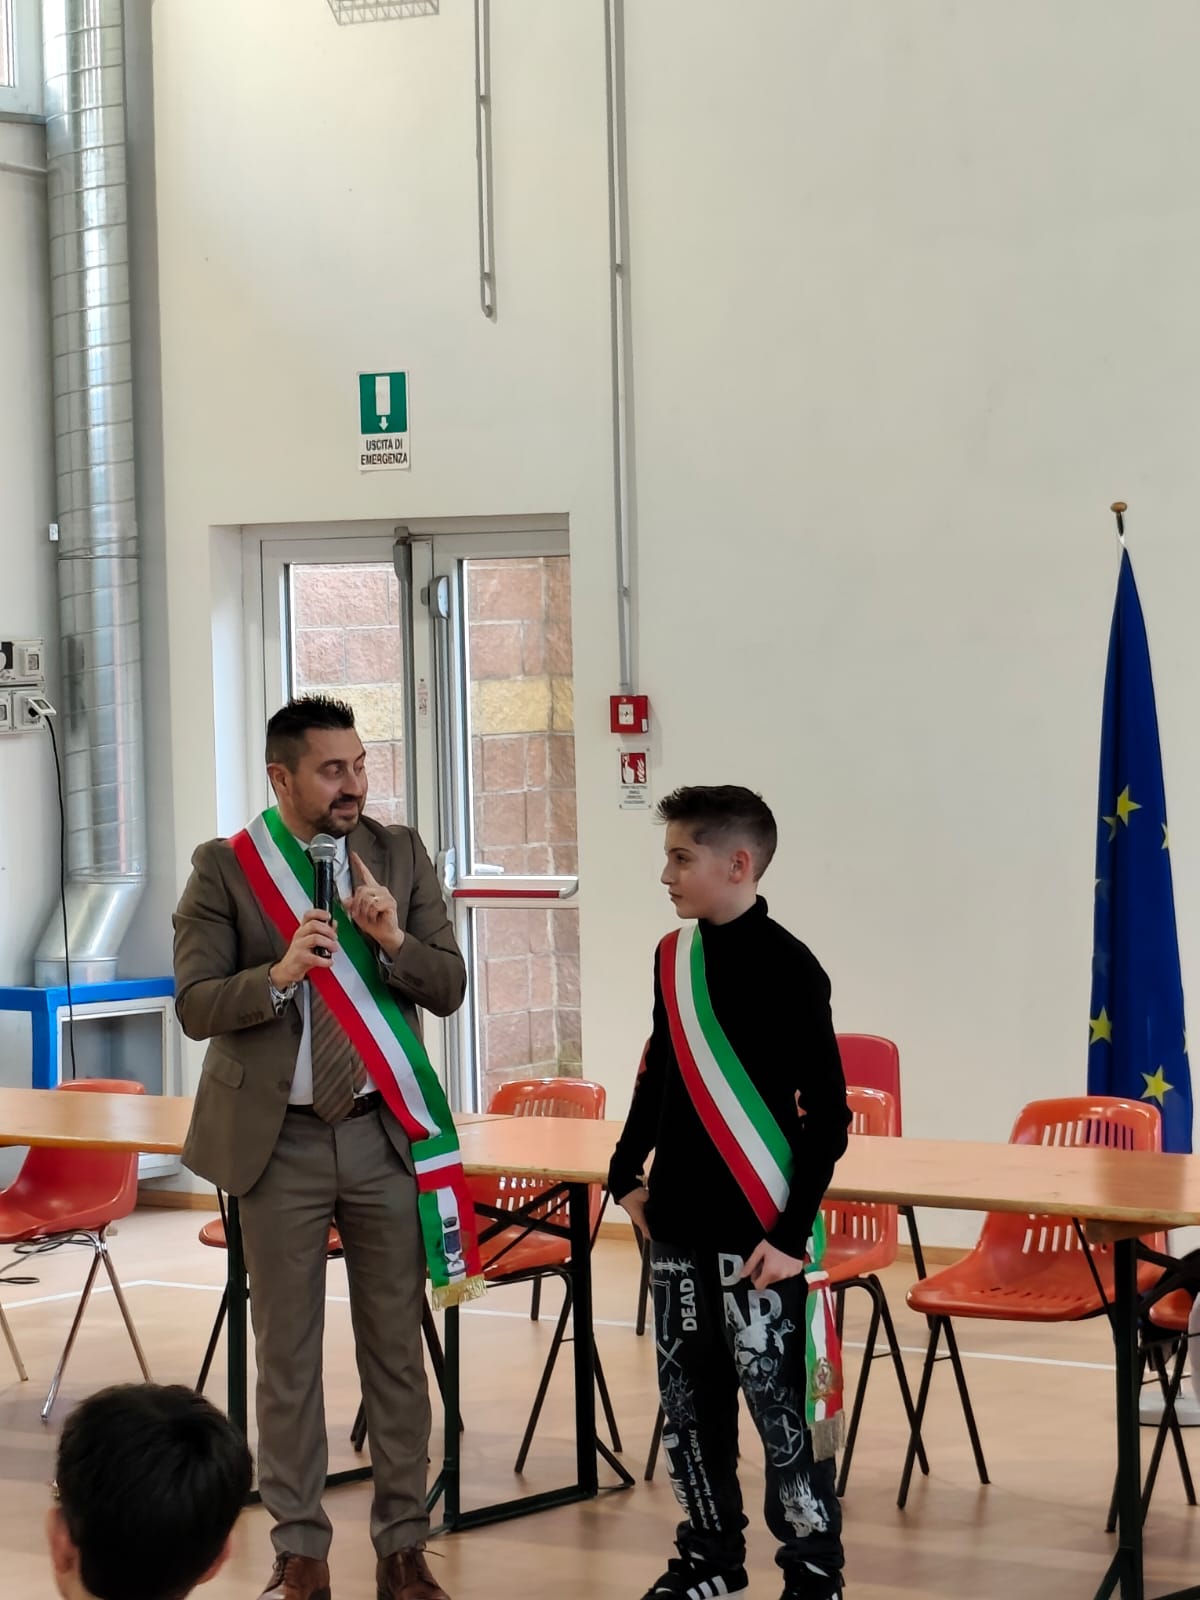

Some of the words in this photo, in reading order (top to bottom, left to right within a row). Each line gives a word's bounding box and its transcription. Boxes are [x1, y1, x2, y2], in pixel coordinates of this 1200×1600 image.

[366, 439, 393, 451] USCITA
[395, 438, 402, 449] DI
[361, 452, 408, 465] EMERGENZA
[680, 1278, 698, 1331] DEAD
